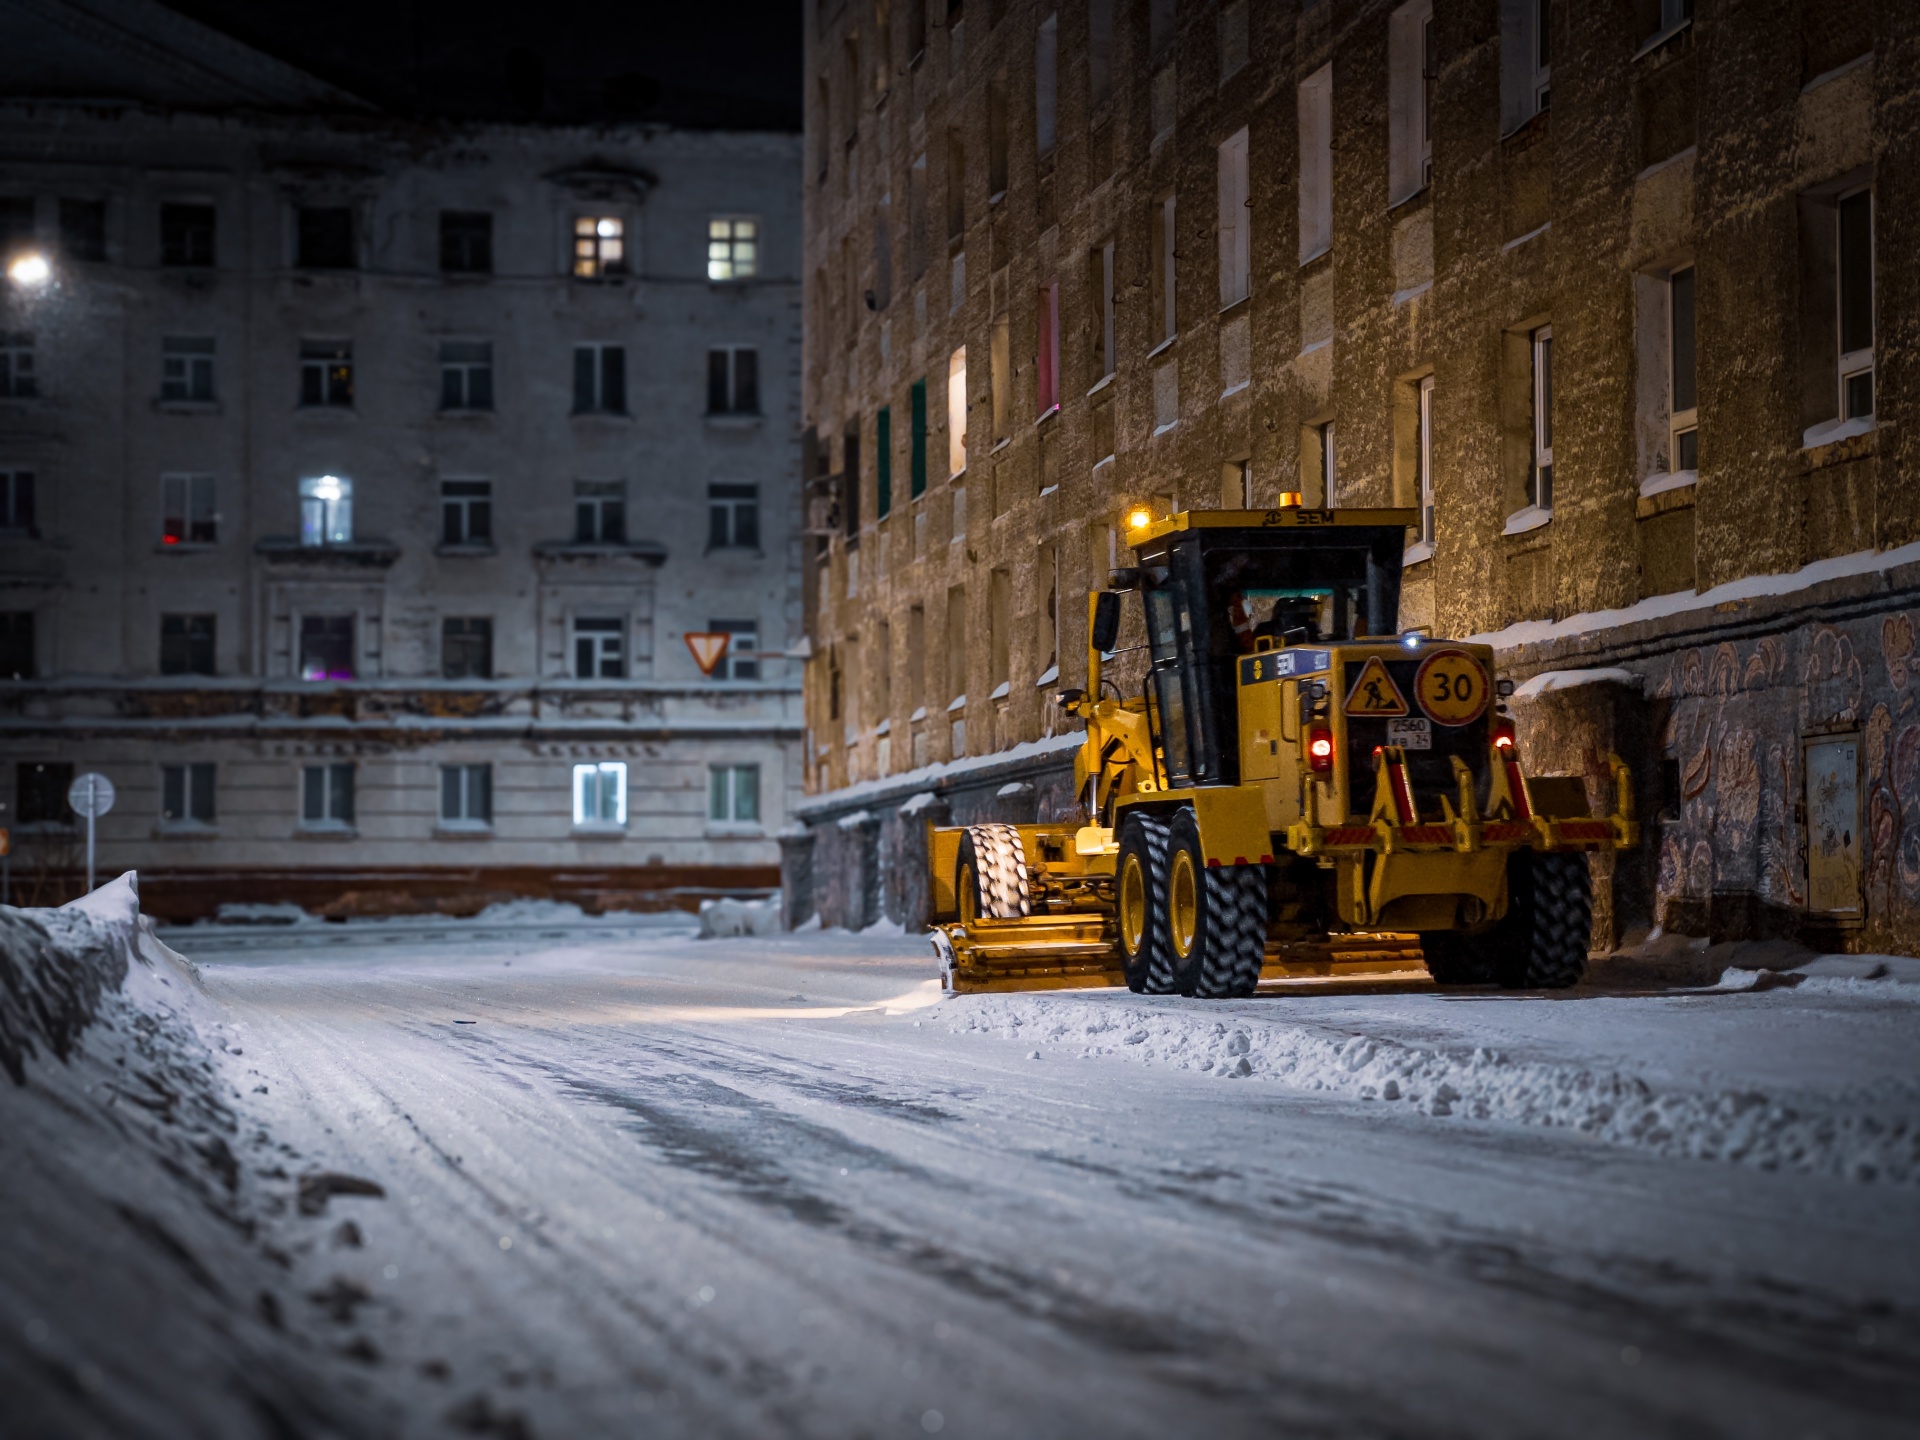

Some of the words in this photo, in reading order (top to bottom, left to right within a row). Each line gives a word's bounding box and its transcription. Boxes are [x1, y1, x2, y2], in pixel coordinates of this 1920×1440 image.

[1296, 511, 1334, 525] SEM
[1433, 673, 1472, 702] 30
[1393, 719, 1426, 733] 2560
